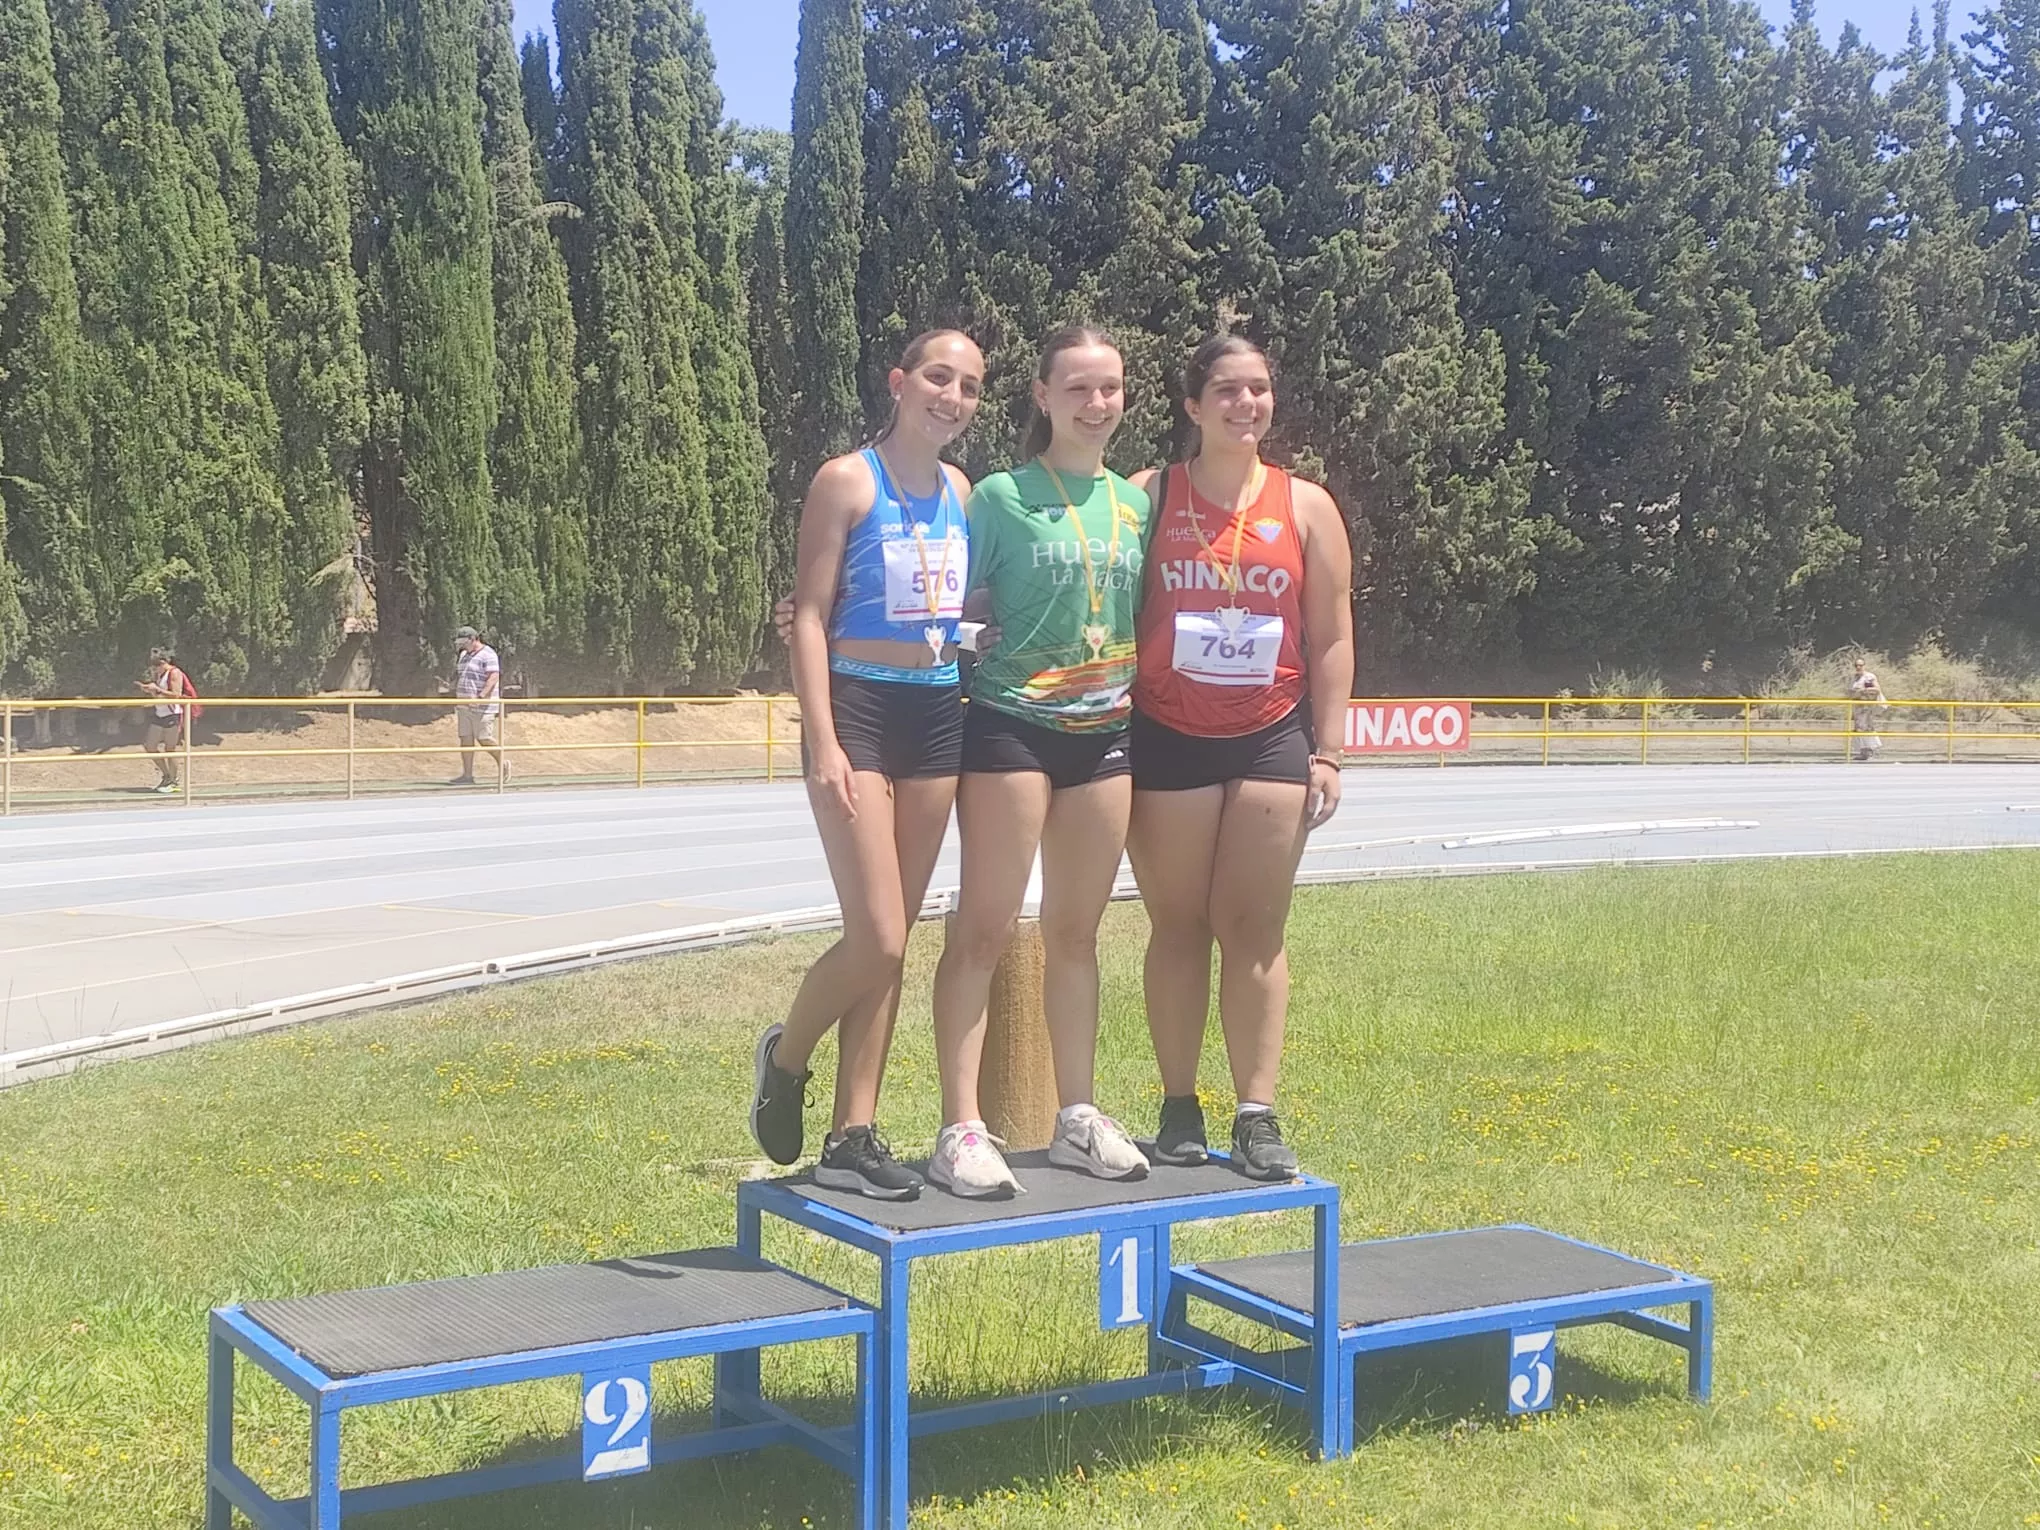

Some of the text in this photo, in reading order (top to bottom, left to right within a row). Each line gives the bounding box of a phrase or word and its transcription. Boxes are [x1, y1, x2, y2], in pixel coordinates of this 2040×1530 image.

[911, 569, 958, 593] 576
[1200, 635, 1256, 659] 764
[1108, 1237, 1144, 1323] 1
[1510, 1330, 1554, 1409] 3
[584, 1377, 648, 1476] 2
